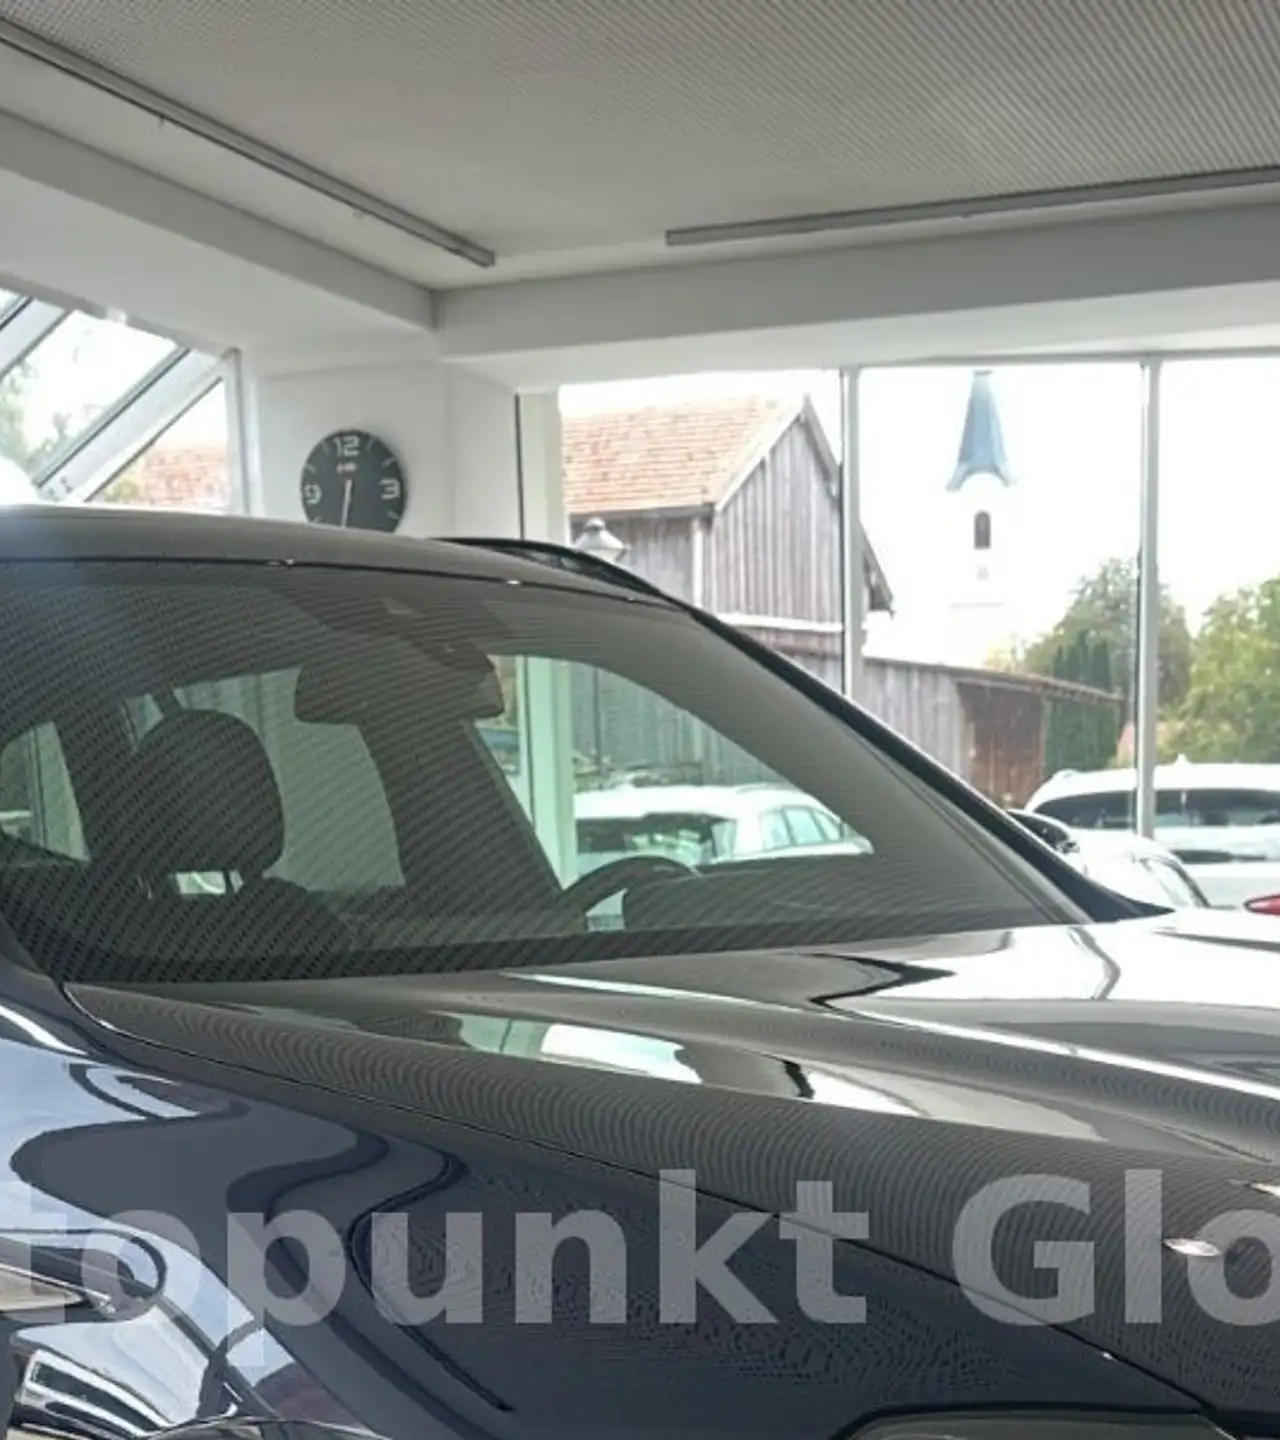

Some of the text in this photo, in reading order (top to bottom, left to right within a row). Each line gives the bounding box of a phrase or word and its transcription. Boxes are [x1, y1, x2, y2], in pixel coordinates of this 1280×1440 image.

[333, 435, 360, 457] 12
[304, 483, 322, 504] 9
[380, 478, 401, 500] 3
